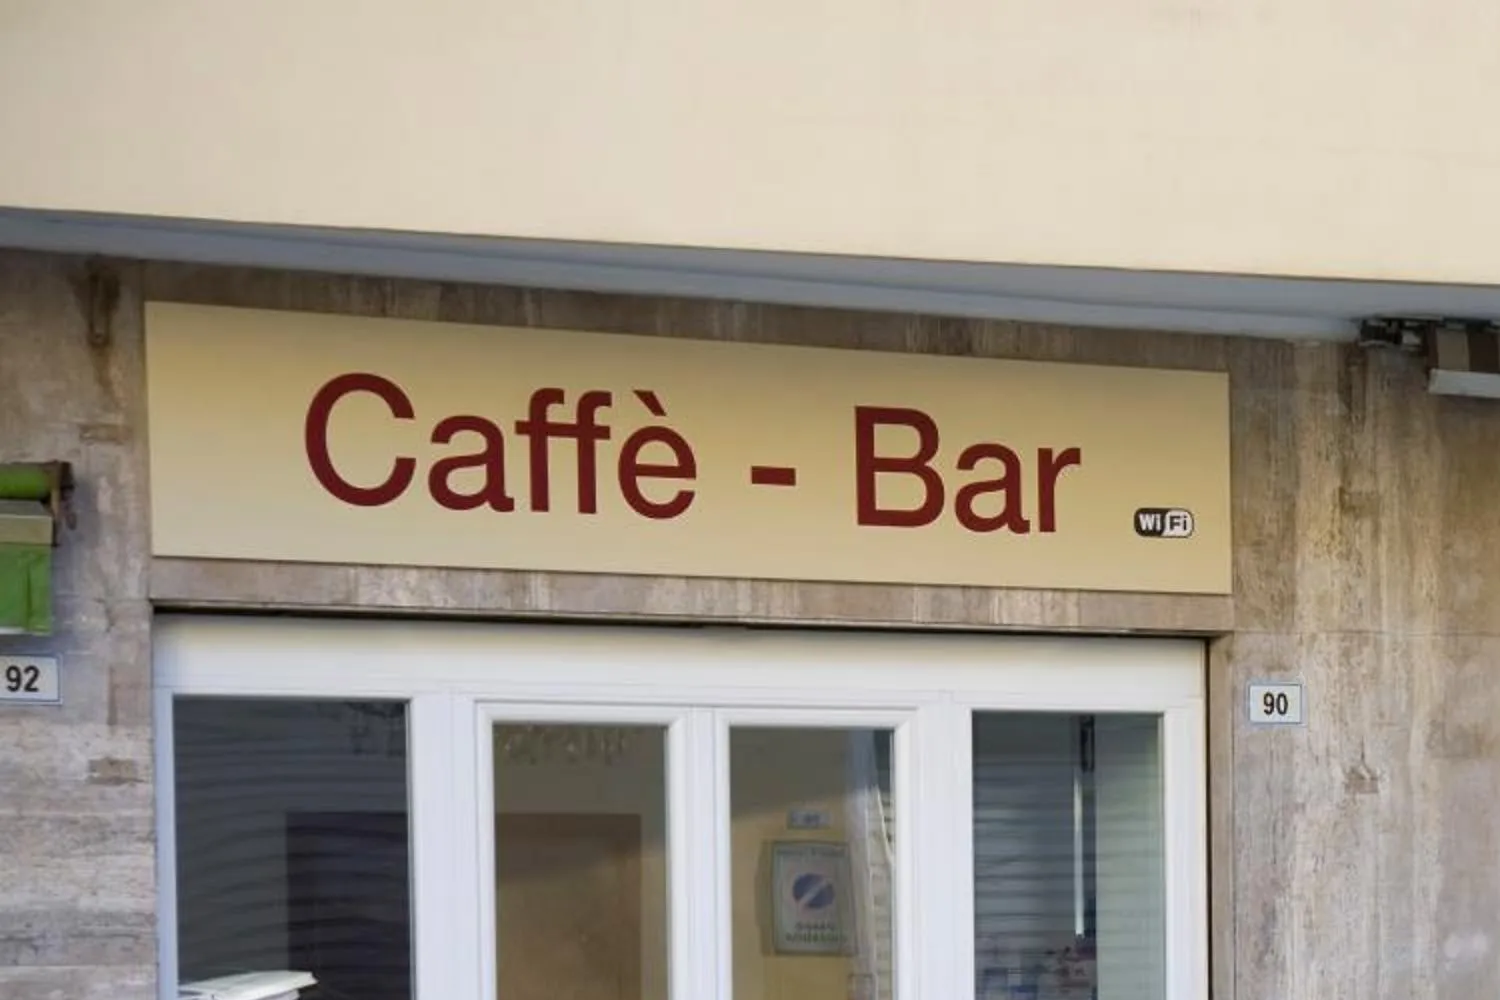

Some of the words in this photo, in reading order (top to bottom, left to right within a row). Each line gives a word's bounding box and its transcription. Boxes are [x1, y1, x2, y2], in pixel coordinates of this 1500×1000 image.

[304, 371, 698, 520] Caffè
[750, 464, 797, 487] -
[854, 405, 1082, 535] Bar
[6, 664, 40, 693] 92
[1263, 691, 1288, 716] 90
